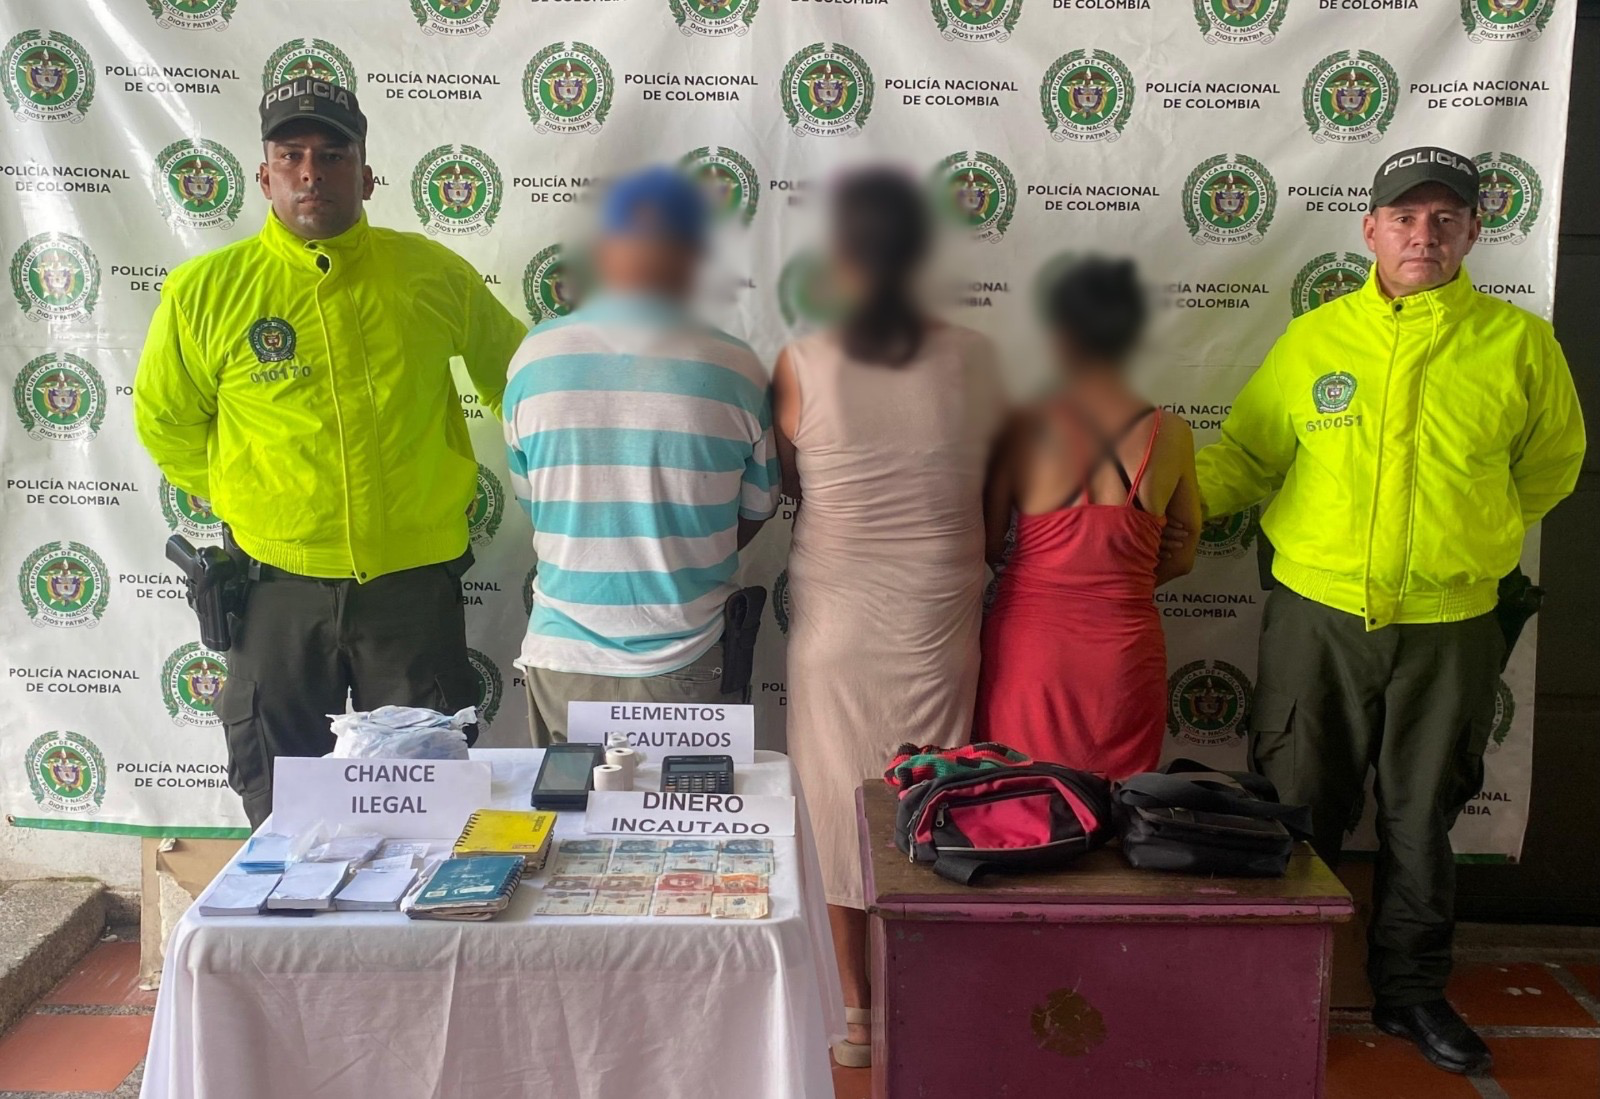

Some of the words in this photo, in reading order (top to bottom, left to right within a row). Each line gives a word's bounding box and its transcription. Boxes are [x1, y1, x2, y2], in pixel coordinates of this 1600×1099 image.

[1053, 0, 1071, 8] DE
[1075, 0, 1150, 9] COLOMBIA
[1320, 0, 1337, 9] DE
[1342, 0, 1418, 9] COLOMBIA
[455, 3, 488, 25] NACIONAL
[976, 9, 1009, 30] NACIONAL
[1240, 11, 1274, 33] NACIONAL
[106, 65, 160, 77] POLICÍA
[163, 67, 239, 79] NACIONAL
[368, 70, 423, 83] POLICÍA
[427, 74, 500, 84] NACIONAL
[581, 56, 603, 93] COLOMBIA
[841, 58, 863, 96] COLOMBIA
[625, 73, 680, 85] POLICÍA
[685, 76, 758, 85] NACIONAL
[885, 77, 940, 89] POLICÍA
[945, 80, 1018, 91] NACIONAL
[1102, 64, 1123, 101] COLOMBIA
[1366, 64, 1387, 102] COLOMBIA
[125, 82, 143, 92] DE
[147, 83, 220, 93] COLOMBIA
[1146, 80, 1201, 93] POLICÍA
[1206, 84, 1280, 93] NACIONAL
[1410, 80, 1468, 93] POLICÍA
[1473, 81, 1549, 91] NACIONAL
[266, 79, 350, 111] POLICIA
[387, 89, 404, 98] DE
[408, 89, 482, 99] COLOMBIA
[644, 90, 661, 100] DE
[666, 91, 739, 101] COLOMBIA
[903, 95, 921, 105] DE
[925, 95, 999, 106] COLOMBIA
[1164, 99, 1181, 108] DE
[1186, 99, 1260, 108] COLOMBIA
[1428, 99, 1447, 108] DE
[1452, 96, 1528, 107] COLOMBIA
[568, 101, 600, 123] NACIONAL
[827, 104, 860, 126] NACIONAL
[1086, 110, 1119, 131] NACIONAL
[1348, 111, 1383, 132] NACIONAL
[1384, 151, 1473, 176] POLICIA
[53, 167, 130, 179] NACIONAL
[470, 159, 492, 196] COLOMBIA
[16, 181, 33, 191] DE
[37, 182, 111, 193] COLOMBIA
[514, 175, 567, 187] POLICÍA
[1244, 168, 1265, 205] COLOMBIA
[1028, 183, 1082, 195] POLICÍA
[1086, 186, 1159, 196] NACIONAL
[1288, 184, 1343, 196] POLICÍA
[532, 193, 548, 202] DE
[1045, 201, 1062, 210] DE
[1067, 201, 1140, 211] COLOMBIA
[1307, 202, 1324, 211] DE
[1328, 202, 1367, 212] COLO
[458, 204, 489, 224] NACIONAL
[1228, 213, 1261, 234] NACIONAL
[112, 264, 168, 276] POLICÍA
[131, 281, 149, 291] DE
[1196, 284, 1269, 293] NACIONAL
[1177, 299, 1249, 308] COLOMBIA
[1306, 415, 1363, 432] 610051
[8, 478, 64, 490] POLICÍA
[68, 481, 138, 491] NACIONAL
[27, 495, 44, 503] DE
[49, 495, 120, 505] COLOMBIA
[78, 555, 100, 591] COLOMBIA
[120, 571, 172, 584] POLICÍA
[464, 582, 501, 591] ONAL
[137, 589, 153, 598] DE
[1183, 594, 1256, 604] NACIONAL
[65, 598, 97, 618] NACIONAL
[1163, 608, 1237, 618] COLOMBIA
[10, 666, 63, 678] POLICÍA
[68, 669, 139, 679] NACIONAL
[27, 683, 44, 692] DE
[48, 683, 121, 693] COLOMBIA
[611, 705, 725, 721] ELEMENTOS
[604, 731, 731, 748] ICAUTADOS
[117, 761, 172, 773] POLICÍA
[176, 764, 229, 774] NACION
[345, 765, 435, 782] CHANCE
[135, 778, 152, 787] DE
[157, 778, 229, 788] COLOMBIA
[352, 796, 427, 813] ILEGAL
[643, 791, 743, 813] DINERO
[611, 817, 770, 835] INCAUTADO
